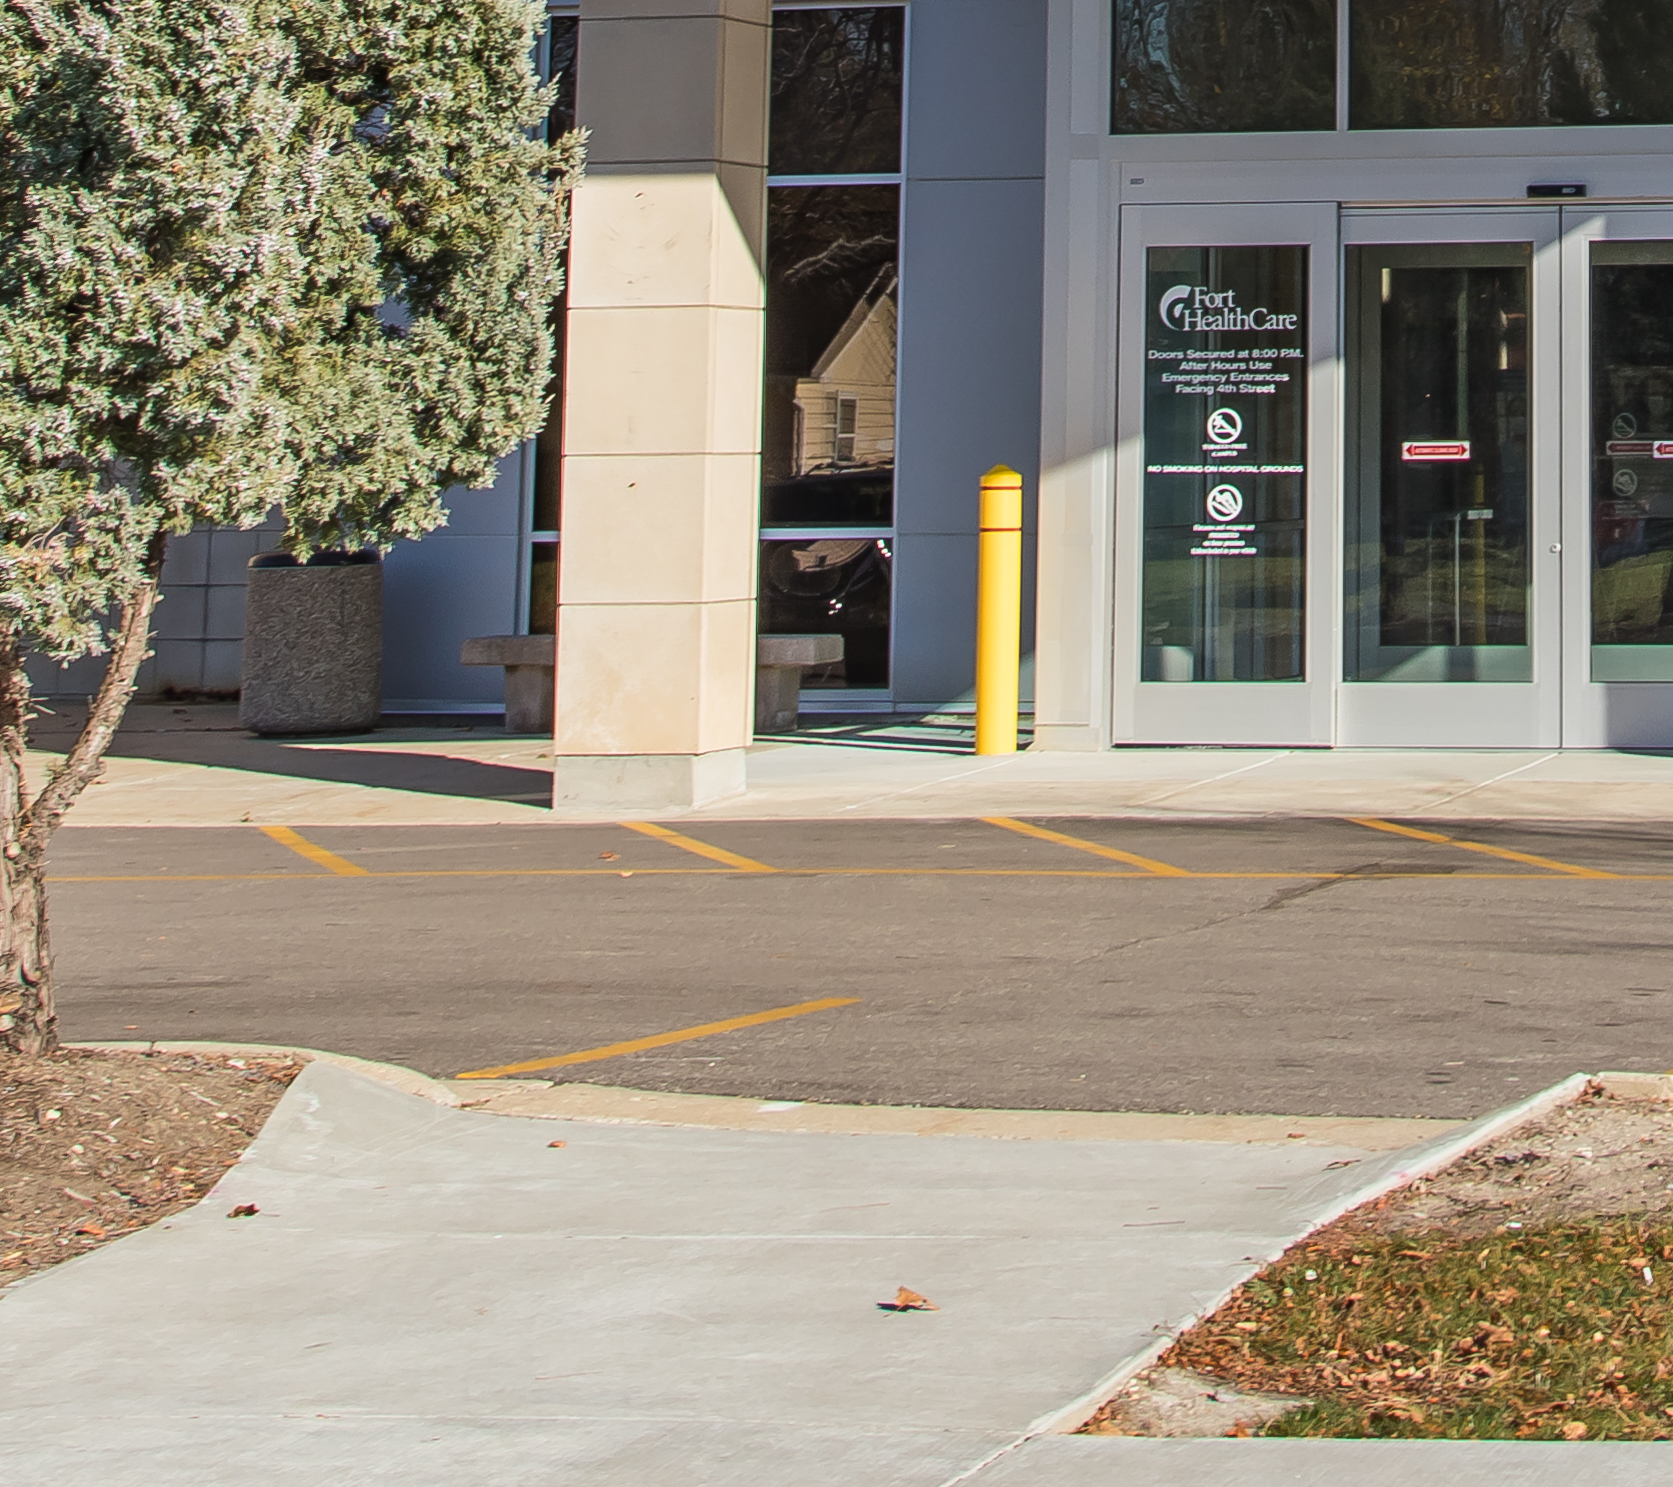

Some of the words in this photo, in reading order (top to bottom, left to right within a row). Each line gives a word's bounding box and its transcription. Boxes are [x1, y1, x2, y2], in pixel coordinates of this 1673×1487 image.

[1192, 286, 1236, 308] Fort
[1182, 307, 1298, 331] HealthCare
[1147, 350, 1184, 359] Doors
[1186, 349, 1235, 359] Secured
[1237, 349, 1249, 359] at
[1251, 348, 1278, 358] 8:00
[1179, 361, 1208, 371] After
[1211, 361, 1247, 370] Hours
[1249, 360, 1273, 370] Use
[1161, 372, 1228, 384] Emergency
[1230, 372, 1291, 382] Entrances
[1175, 384, 1214, 396] Facing
[1216, 384, 1237, 393] 4th
[1239, 383, 1276, 394] Street
[1147, 465, 1162, 473] NO
[1162, 465, 1204, 473] SMOKING
[1218, 465, 1260, 473] HOSPITAL
[1260, 464, 1304, 473] GROUNDS
